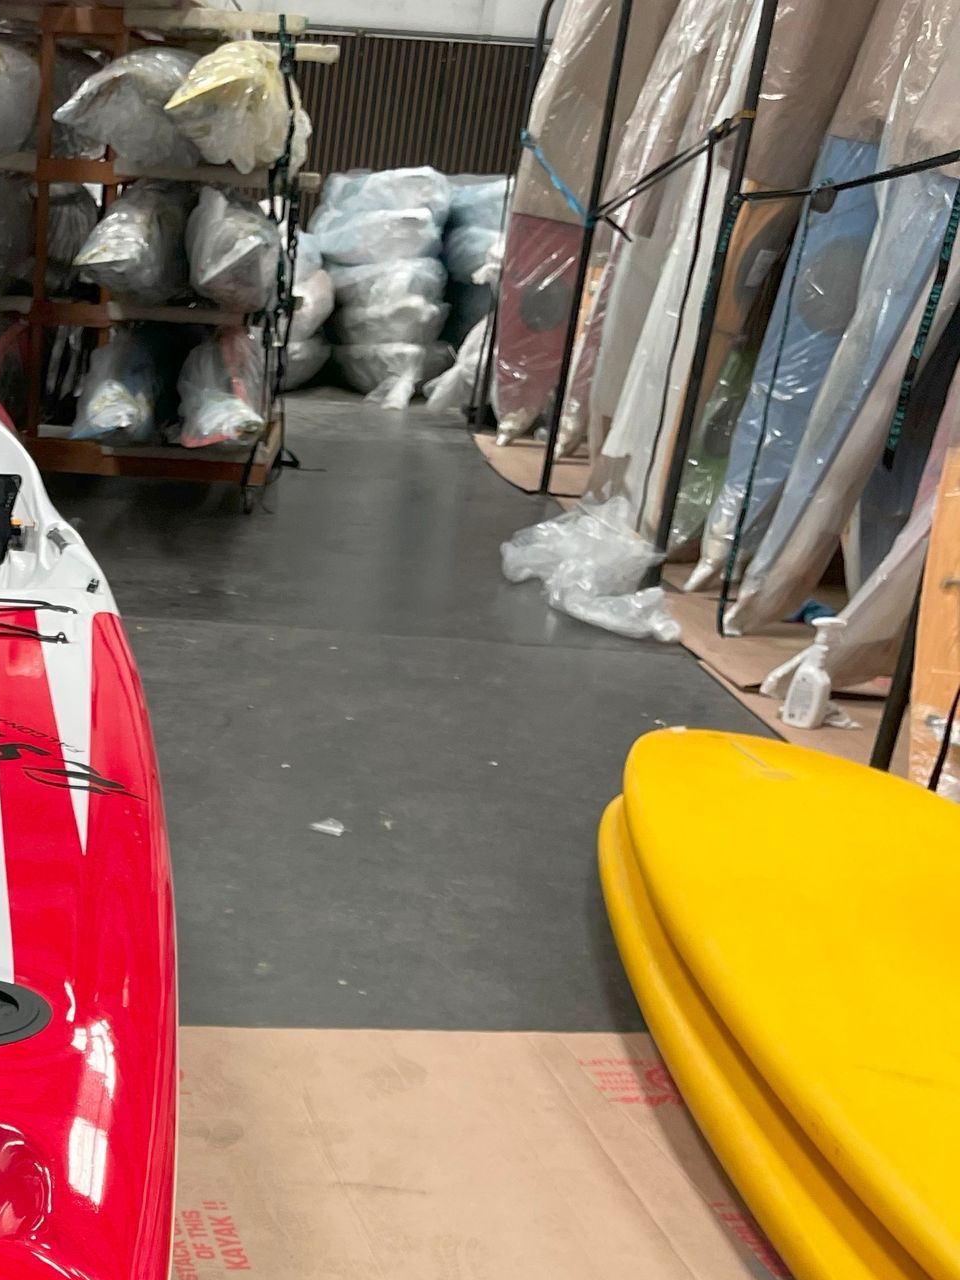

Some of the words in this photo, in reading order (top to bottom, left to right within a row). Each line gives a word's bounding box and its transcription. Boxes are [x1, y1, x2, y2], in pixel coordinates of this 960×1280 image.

[182, 1210, 208, 1238] THIS
[192, 1243, 215, 1259] OF
[208, 1215, 251, 1270] KAYAK
